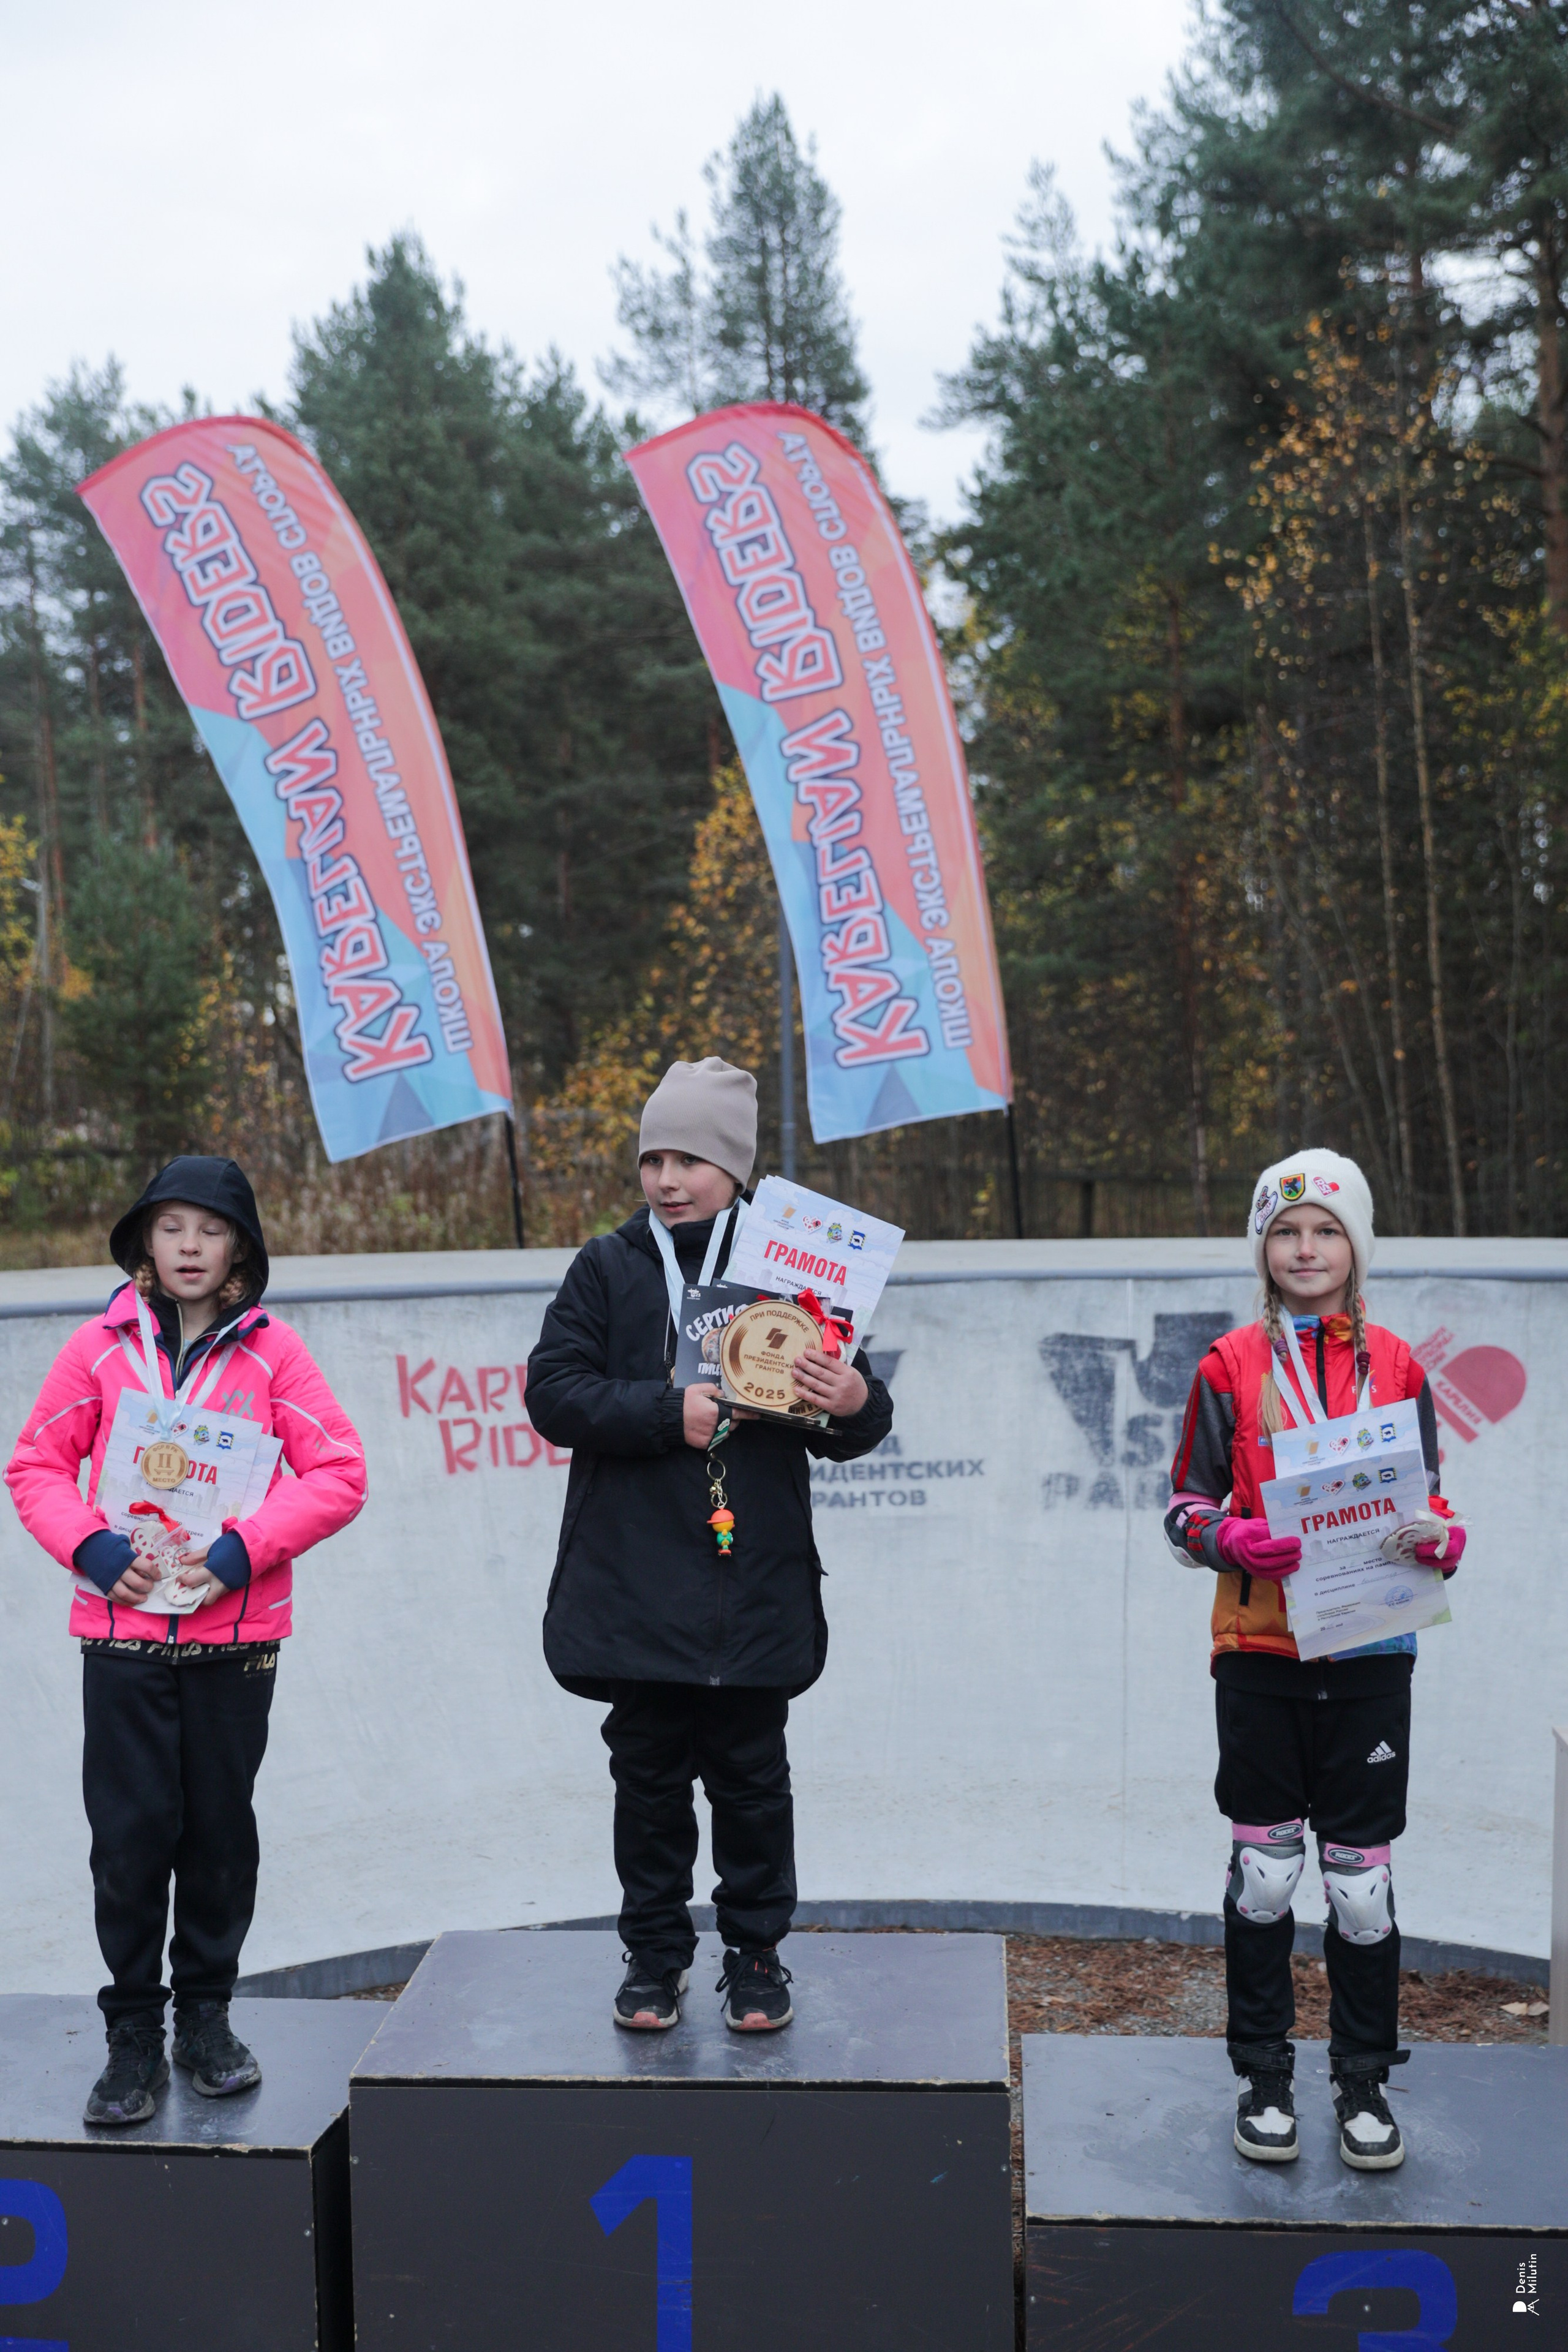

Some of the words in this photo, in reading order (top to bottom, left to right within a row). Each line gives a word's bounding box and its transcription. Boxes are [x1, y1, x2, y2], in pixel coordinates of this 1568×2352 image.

[763, 1239, 848, 1286] ГРАМОТА
[775, 1276, 822, 1296] НАГРАЖДАТСЯ
[750, 1311, 765, 1322] ПРИ
[766, 1310, 810, 1333] ПОДДЕРЖКЕ
[744, 1354, 796, 1370] ПРЕЗИДЕНТСКИ
[761, 1351, 785, 1360] ФОНДА
[755, 1363, 784, 1374] ГРАНТОВ
[743, 1382, 785, 1400] 2025
[1300, 1497, 1397, 1534] ГРАМОТА
[1327, 1528, 1380, 1545] НАГРАЖДАЕТСЯ
[1363, 1556, 1382, 1565] место
[1316, 1566, 1365, 1582] соревнованиях
[1319, 1583, 1355, 1596] дисциплине
[244, 1653, 276, 1672] FILA
[1366, 1751, 1396, 1763] adidas
[589, 2154, 693, 2352] 1
